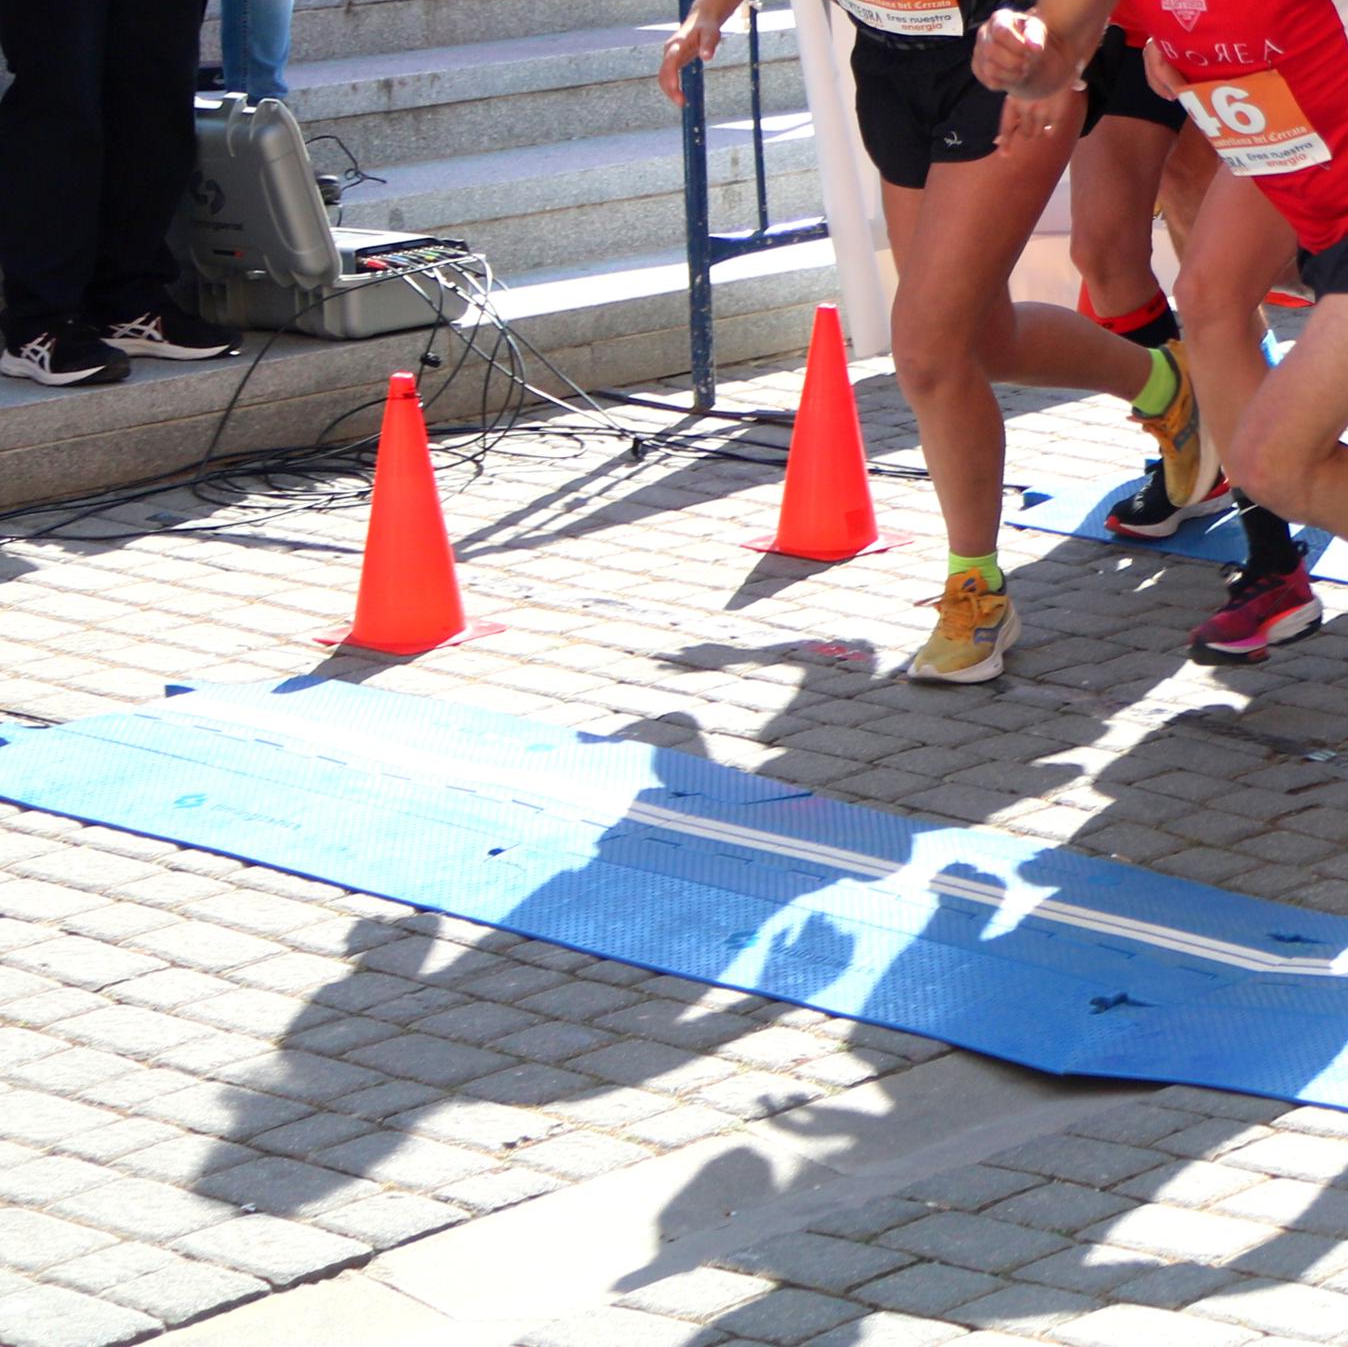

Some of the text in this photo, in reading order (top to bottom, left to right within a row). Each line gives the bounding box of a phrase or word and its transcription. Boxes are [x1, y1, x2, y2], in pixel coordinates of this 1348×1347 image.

[914, 0, 952, 10] Cerrato
[909, 13, 953, 24] nuestra
[1177, 85, 1267, 138] 46
